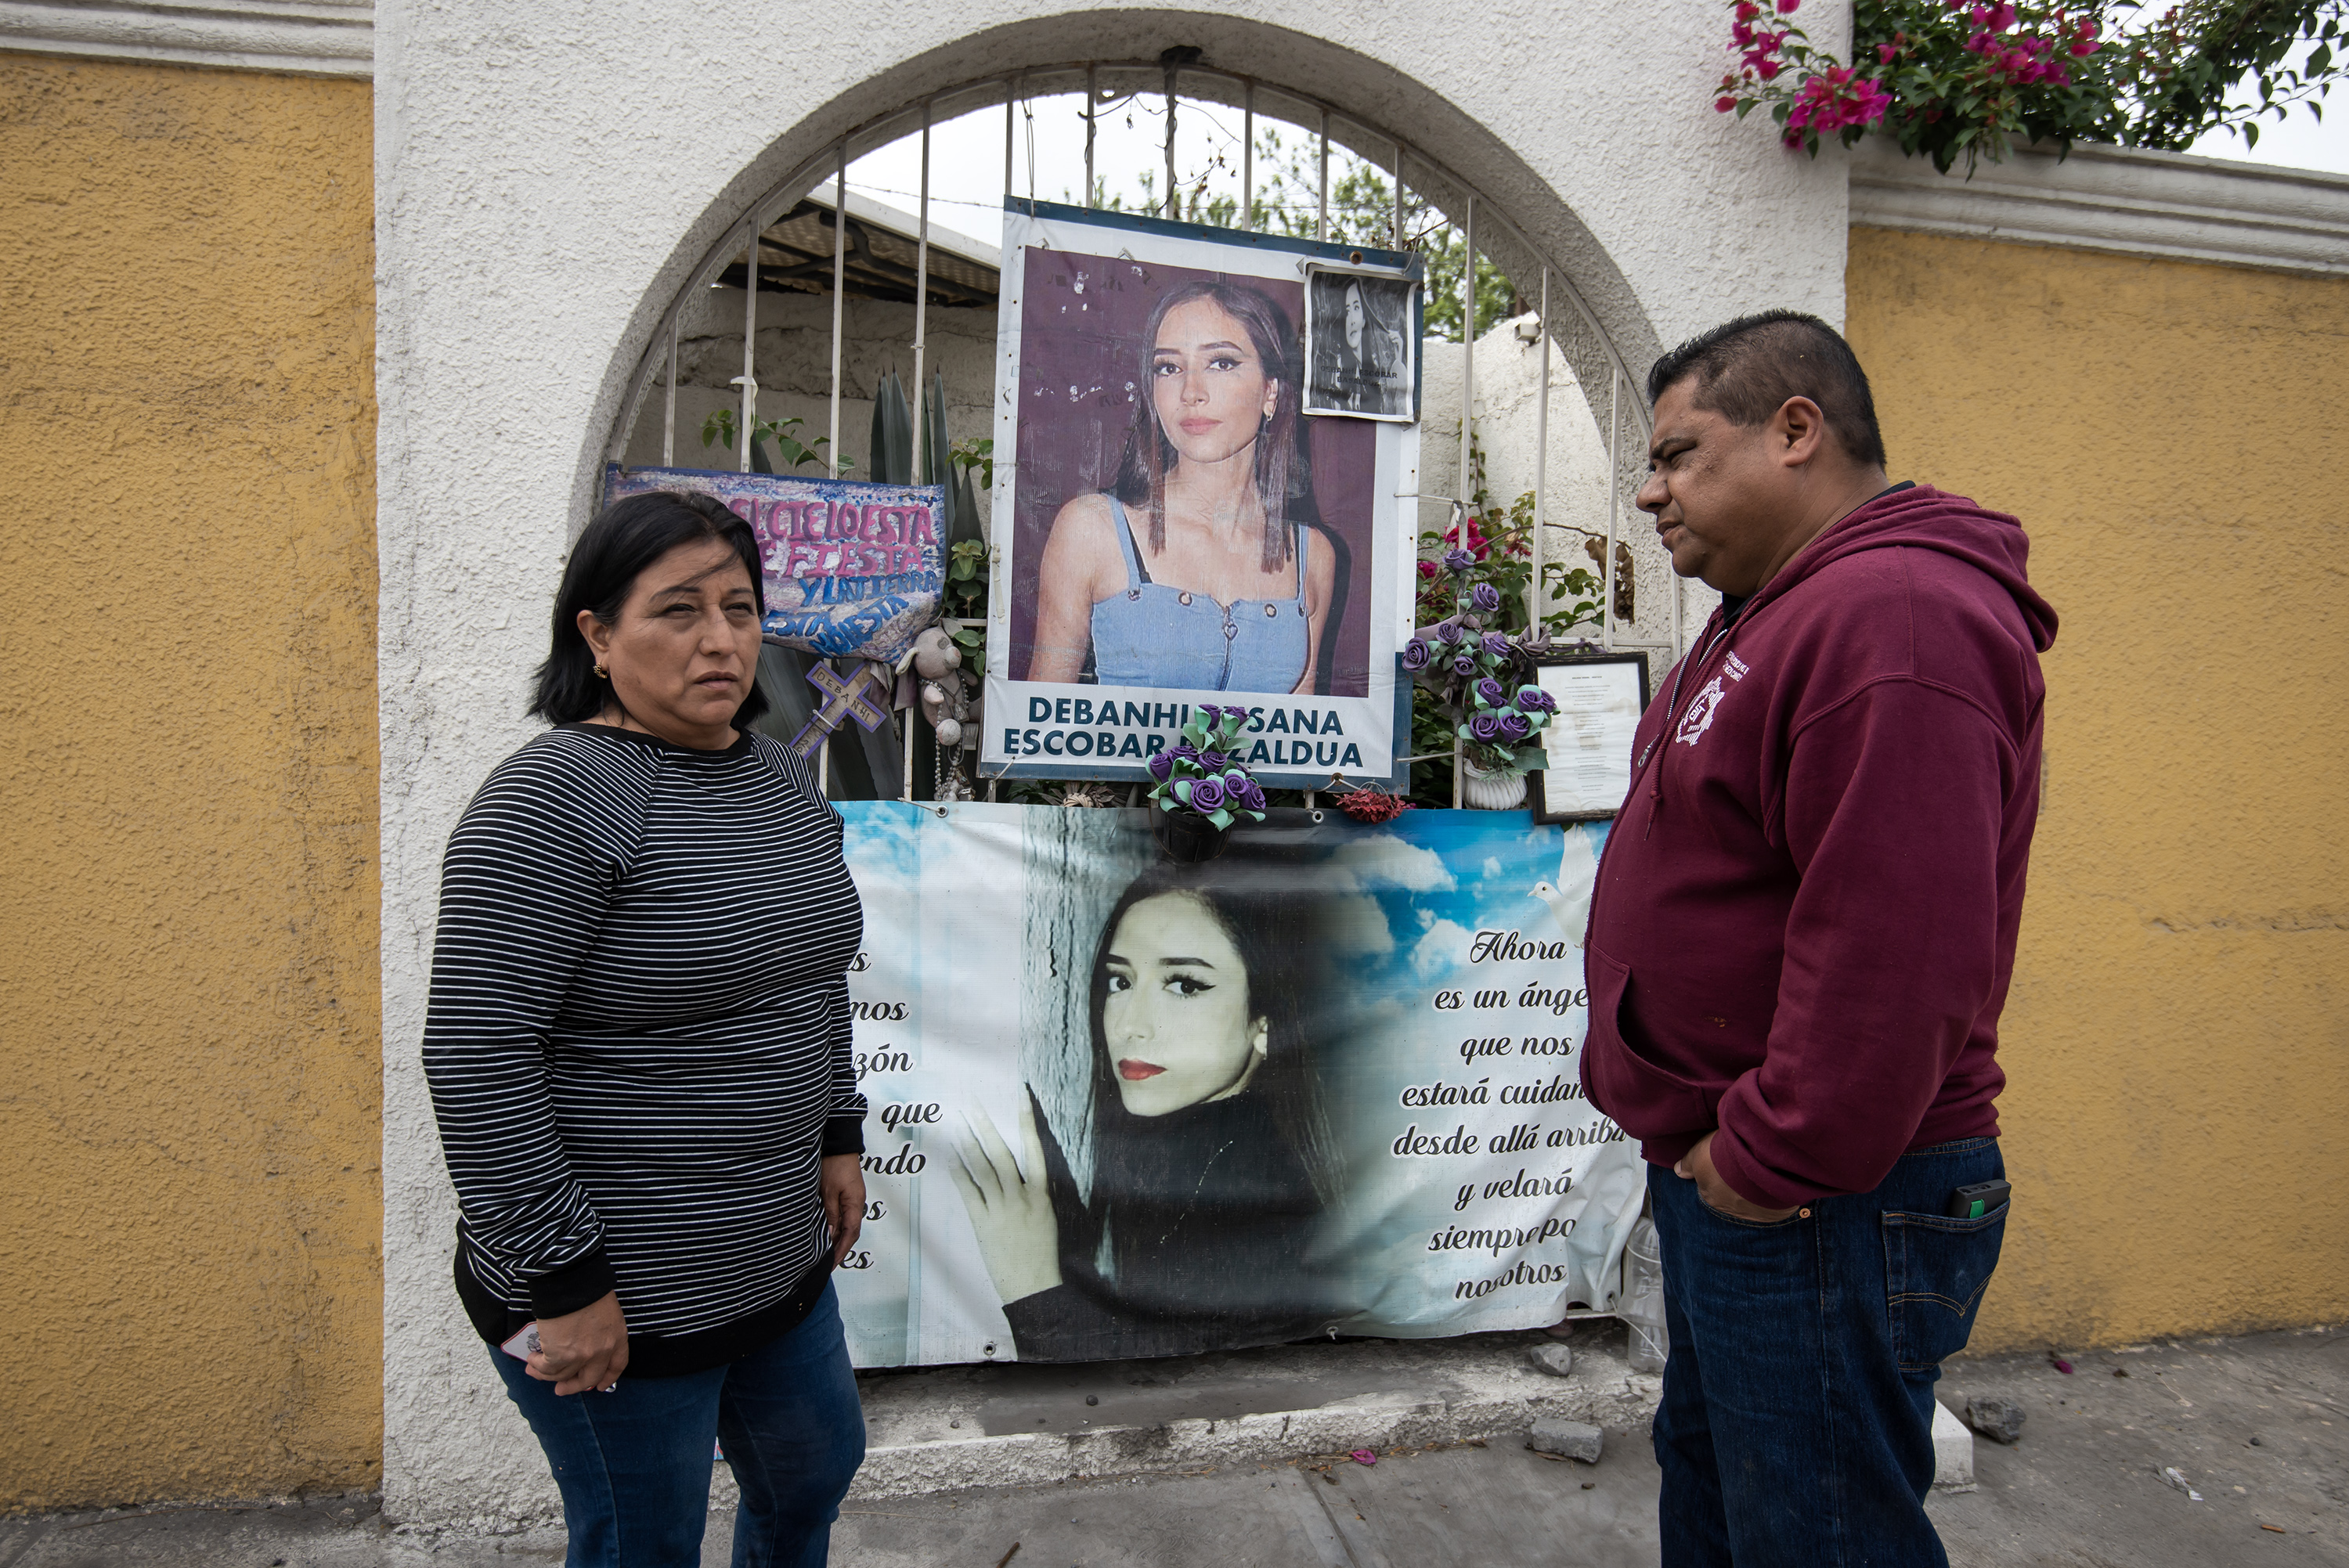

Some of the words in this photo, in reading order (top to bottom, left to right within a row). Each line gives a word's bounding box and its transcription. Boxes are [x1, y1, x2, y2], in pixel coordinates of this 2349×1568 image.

[1359, 369, 1398, 379] ESCOBAR
[767, 500, 860, 542] CIELO
[785, 541, 925, 578] FIESTA
[817, 672, 870, 721] DEBANHI
[1029, 697, 1189, 729] DEBANHI
[1224, 706, 1344, 736] SANA
[1004, 728, 1166, 759] ESCOBAR
[1470, 931, 1568, 964] Ahora
[1434, 989, 1465, 1010] es
[1473, 989, 1510, 1008] un
[1518, 981, 1589, 1016] ánge
[1460, 1036, 1513, 1065] que
[1521, 1036, 1575, 1056] nos
[1402, 1077, 1491, 1107] estará
[882, 1103, 943, 1133] que
[1394, 1125, 1480, 1155] desde
[1488, 1123, 1541, 1153] allá
[1546, 1116, 1627, 1148] arriba
[1454, 1183, 1476, 1211] y
[1483, 1167, 1575, 1199] velará
[1456, 1260, 1568, 1299] nosotros
